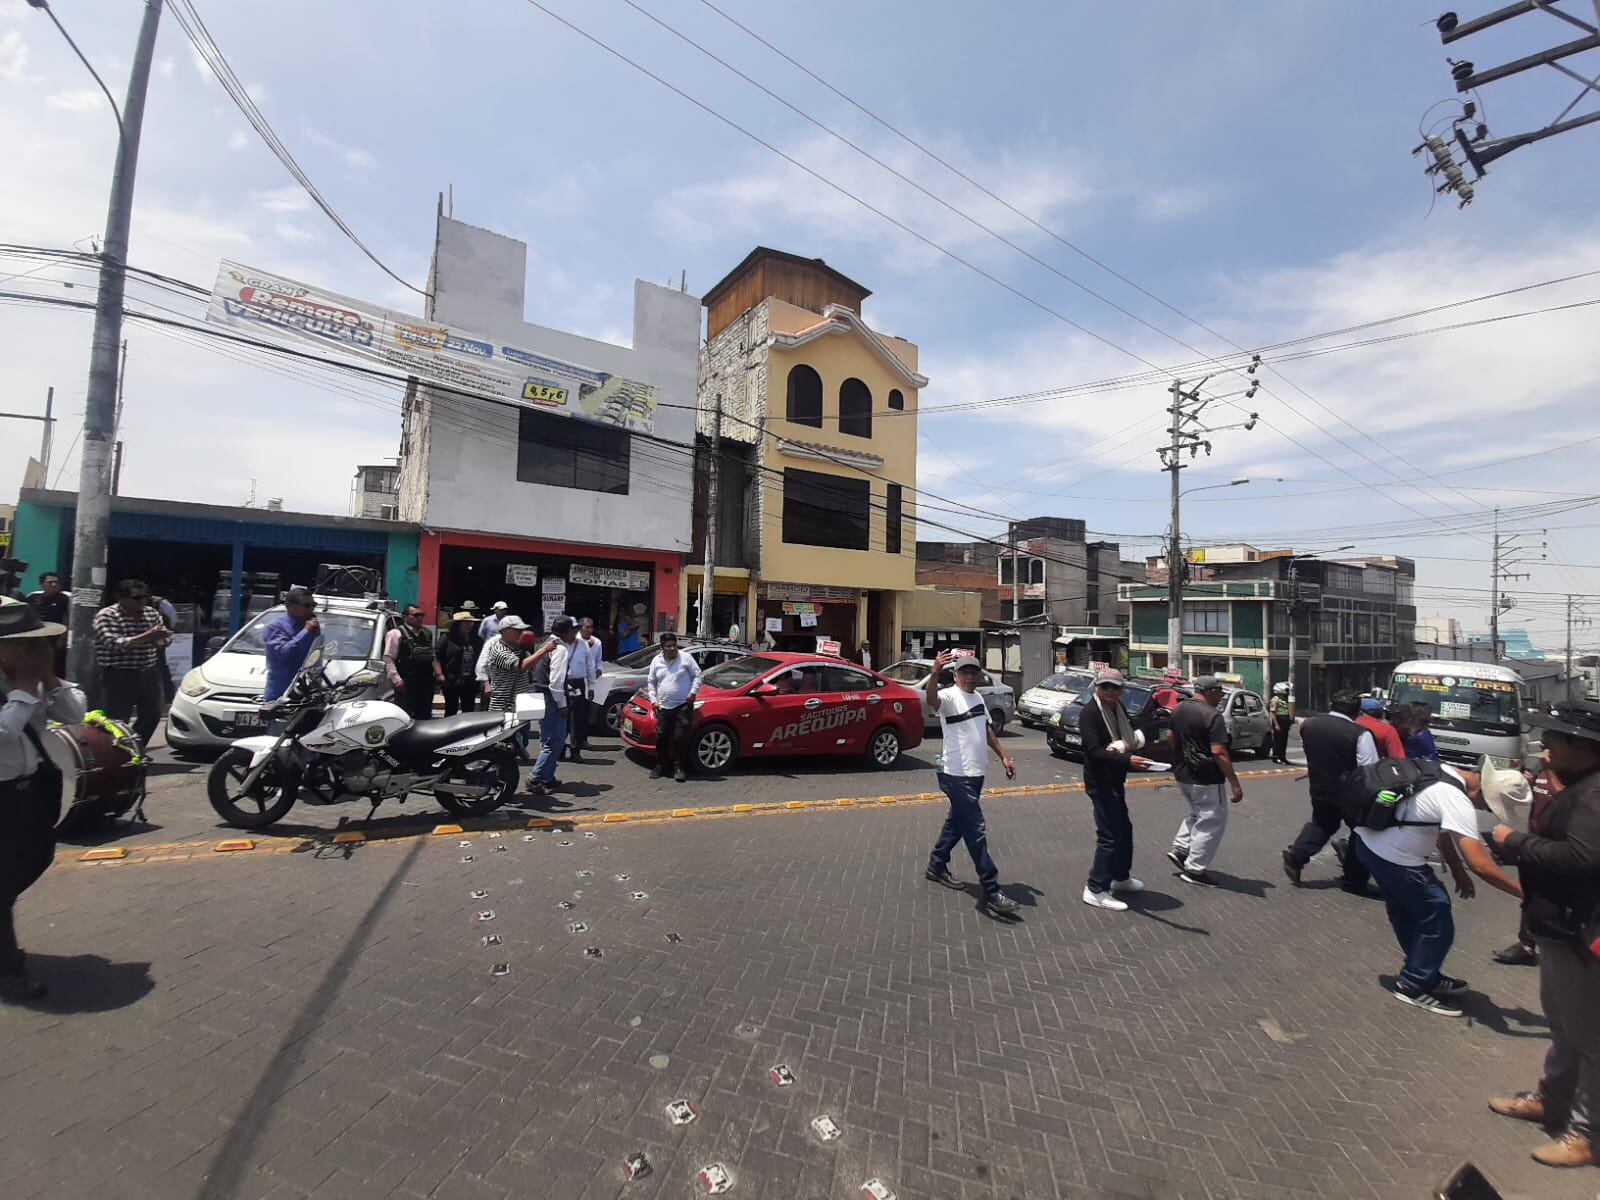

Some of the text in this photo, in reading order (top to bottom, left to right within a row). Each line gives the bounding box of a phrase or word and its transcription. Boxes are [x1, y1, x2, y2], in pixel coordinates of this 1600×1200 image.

[247, 278, 294, 295] GRAN
[252, 288, 361, 327] Remate
[224, 297, 374, 347] VEHICULAR
[463, 343, 487, 356] Nov.
[573, 565, 628, 578] IMPRESIONES
[572, 577, 627, 587] COPIAS
[769, 707, 867, 742] AREQUIPA
